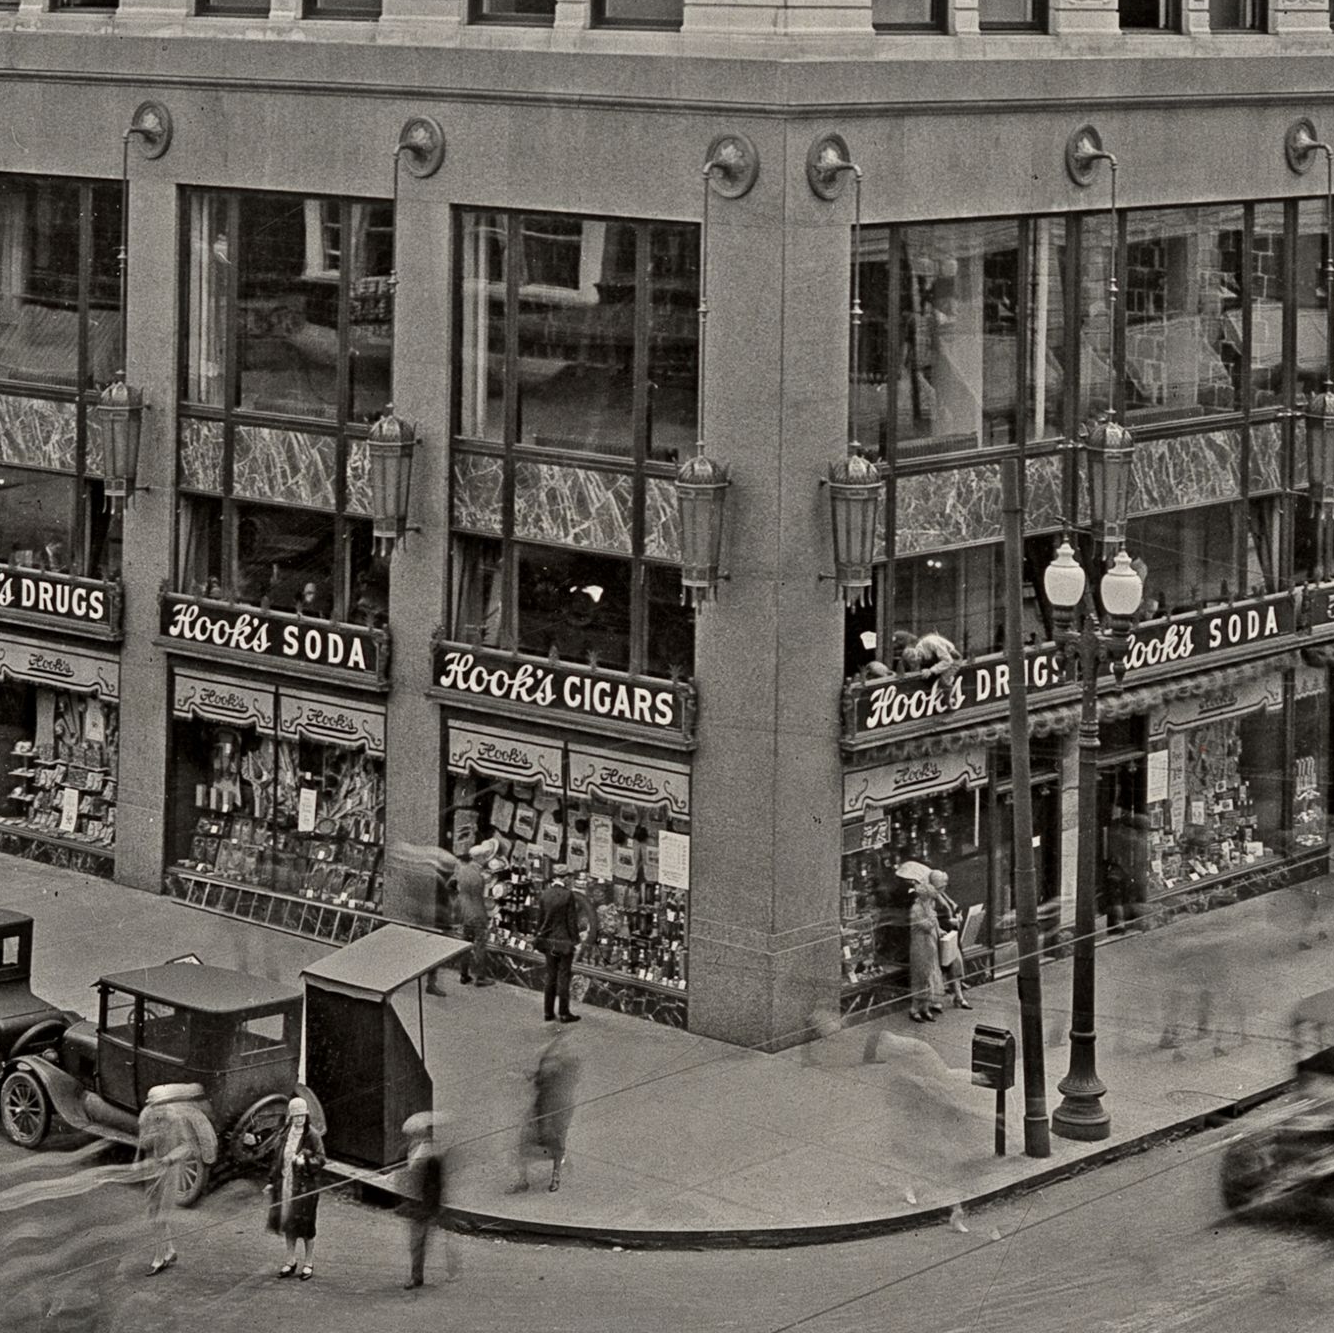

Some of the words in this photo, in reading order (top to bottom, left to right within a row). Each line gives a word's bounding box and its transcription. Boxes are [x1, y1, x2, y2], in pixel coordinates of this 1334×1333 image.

[21, 578, 104, 620] DRUGS
[169, 603, 271, 653] Hook's
[283, 625, 366, 670] SODA
[1209, 605, 1279, 649] SODA
[28, 652, 75, 675] Hook's
[199, 688, 248, 710] Hook's
[440, 652, 556, 707] Hook's
[563, 675, 674, 726] CIGARS
[306, 708, 357, 731] Hook's
[477, 741, 532, 766] Hook's
[600, 766, 658, 793] Hook's
[894, 762, 941, 783] Hook's
